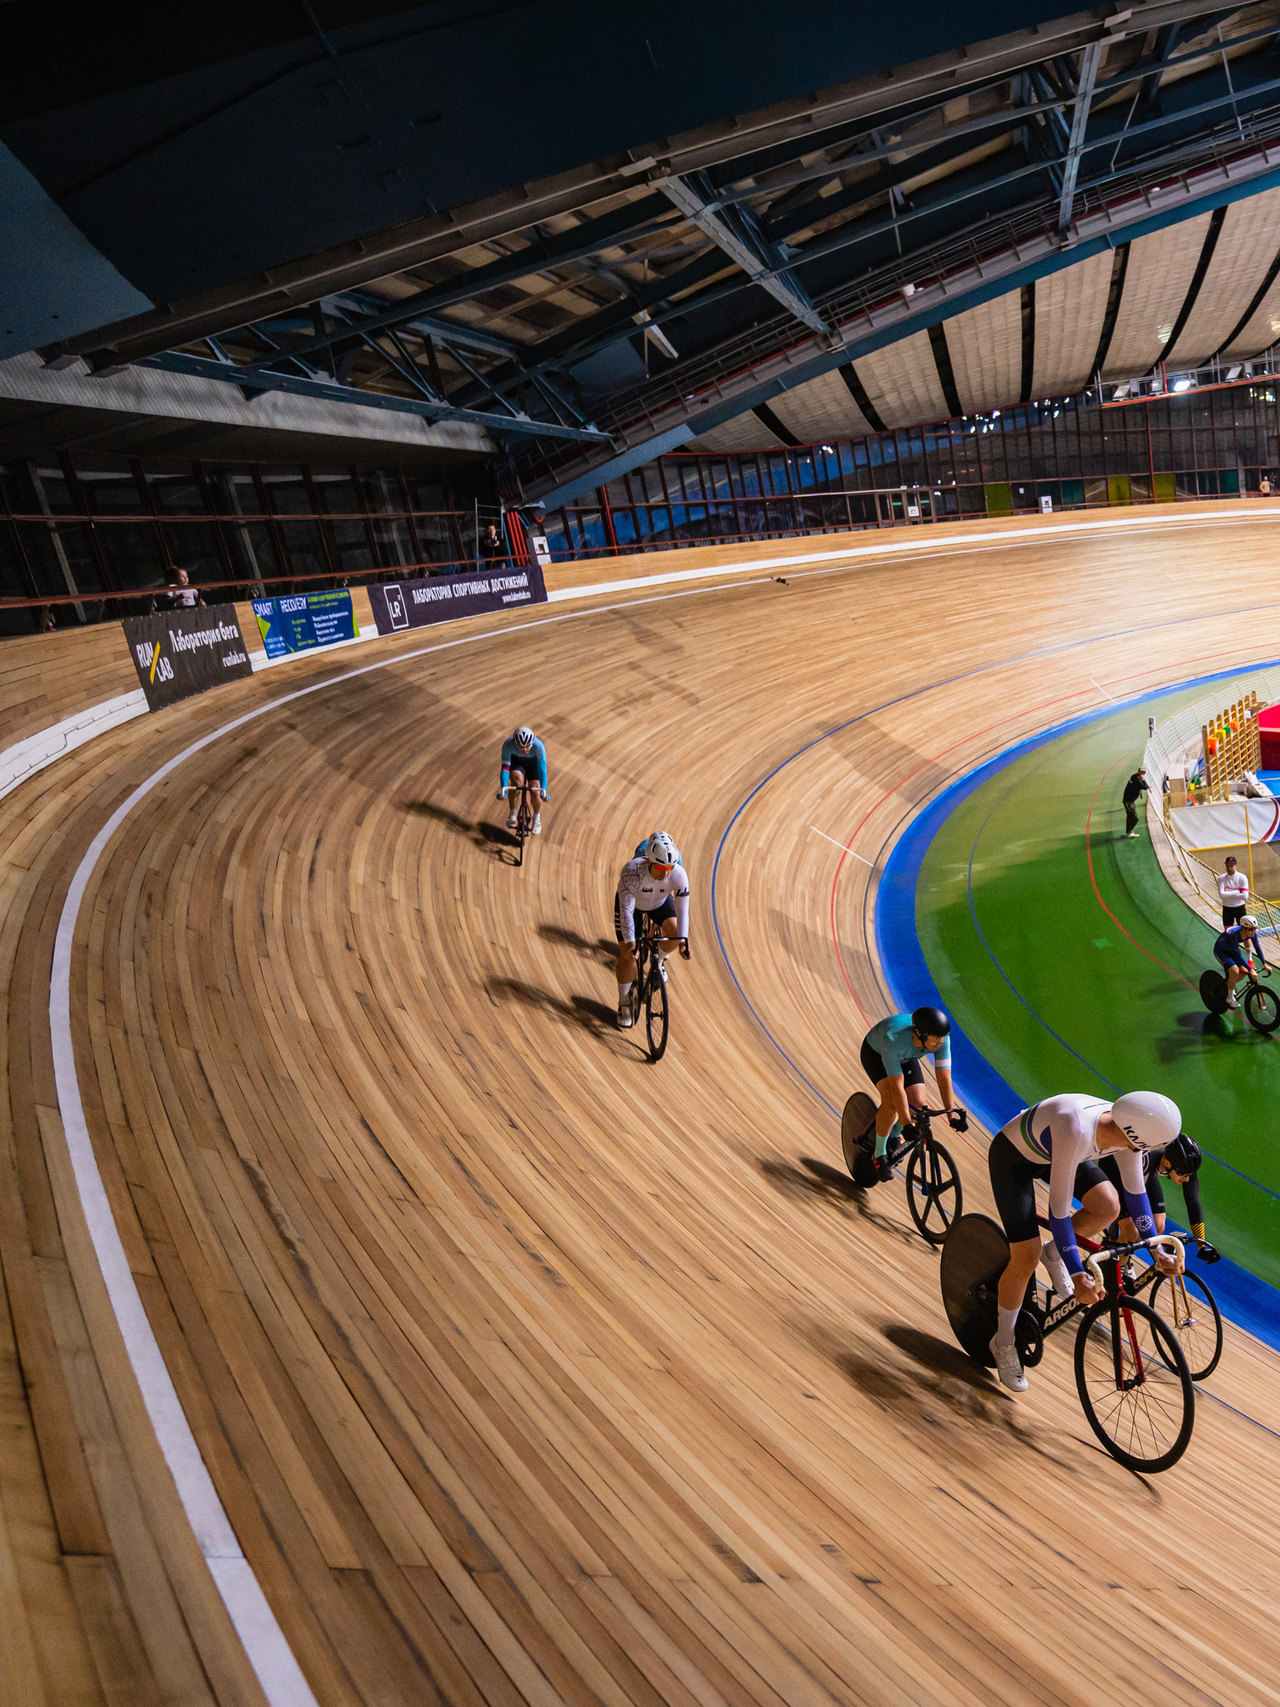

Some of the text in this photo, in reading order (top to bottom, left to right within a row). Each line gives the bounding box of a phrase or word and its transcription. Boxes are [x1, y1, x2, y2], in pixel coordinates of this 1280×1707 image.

[412, 572, 529, 605] ЛАБОРАТОРИЯ СПОРТИВНЫХ ДОСТИЖЕНИЙ
[254, 602, 273, 617] SMART
[280, 597, 307, 613] RECOVERY
[389, 601, 402, 618] LR
[169, 628, 221, 653] Лаборатория
[136, 642, 154, 668] RUN
[156, 657, 174, 682] LAB
[1043, 1298, 1080, 1330] ARGO
